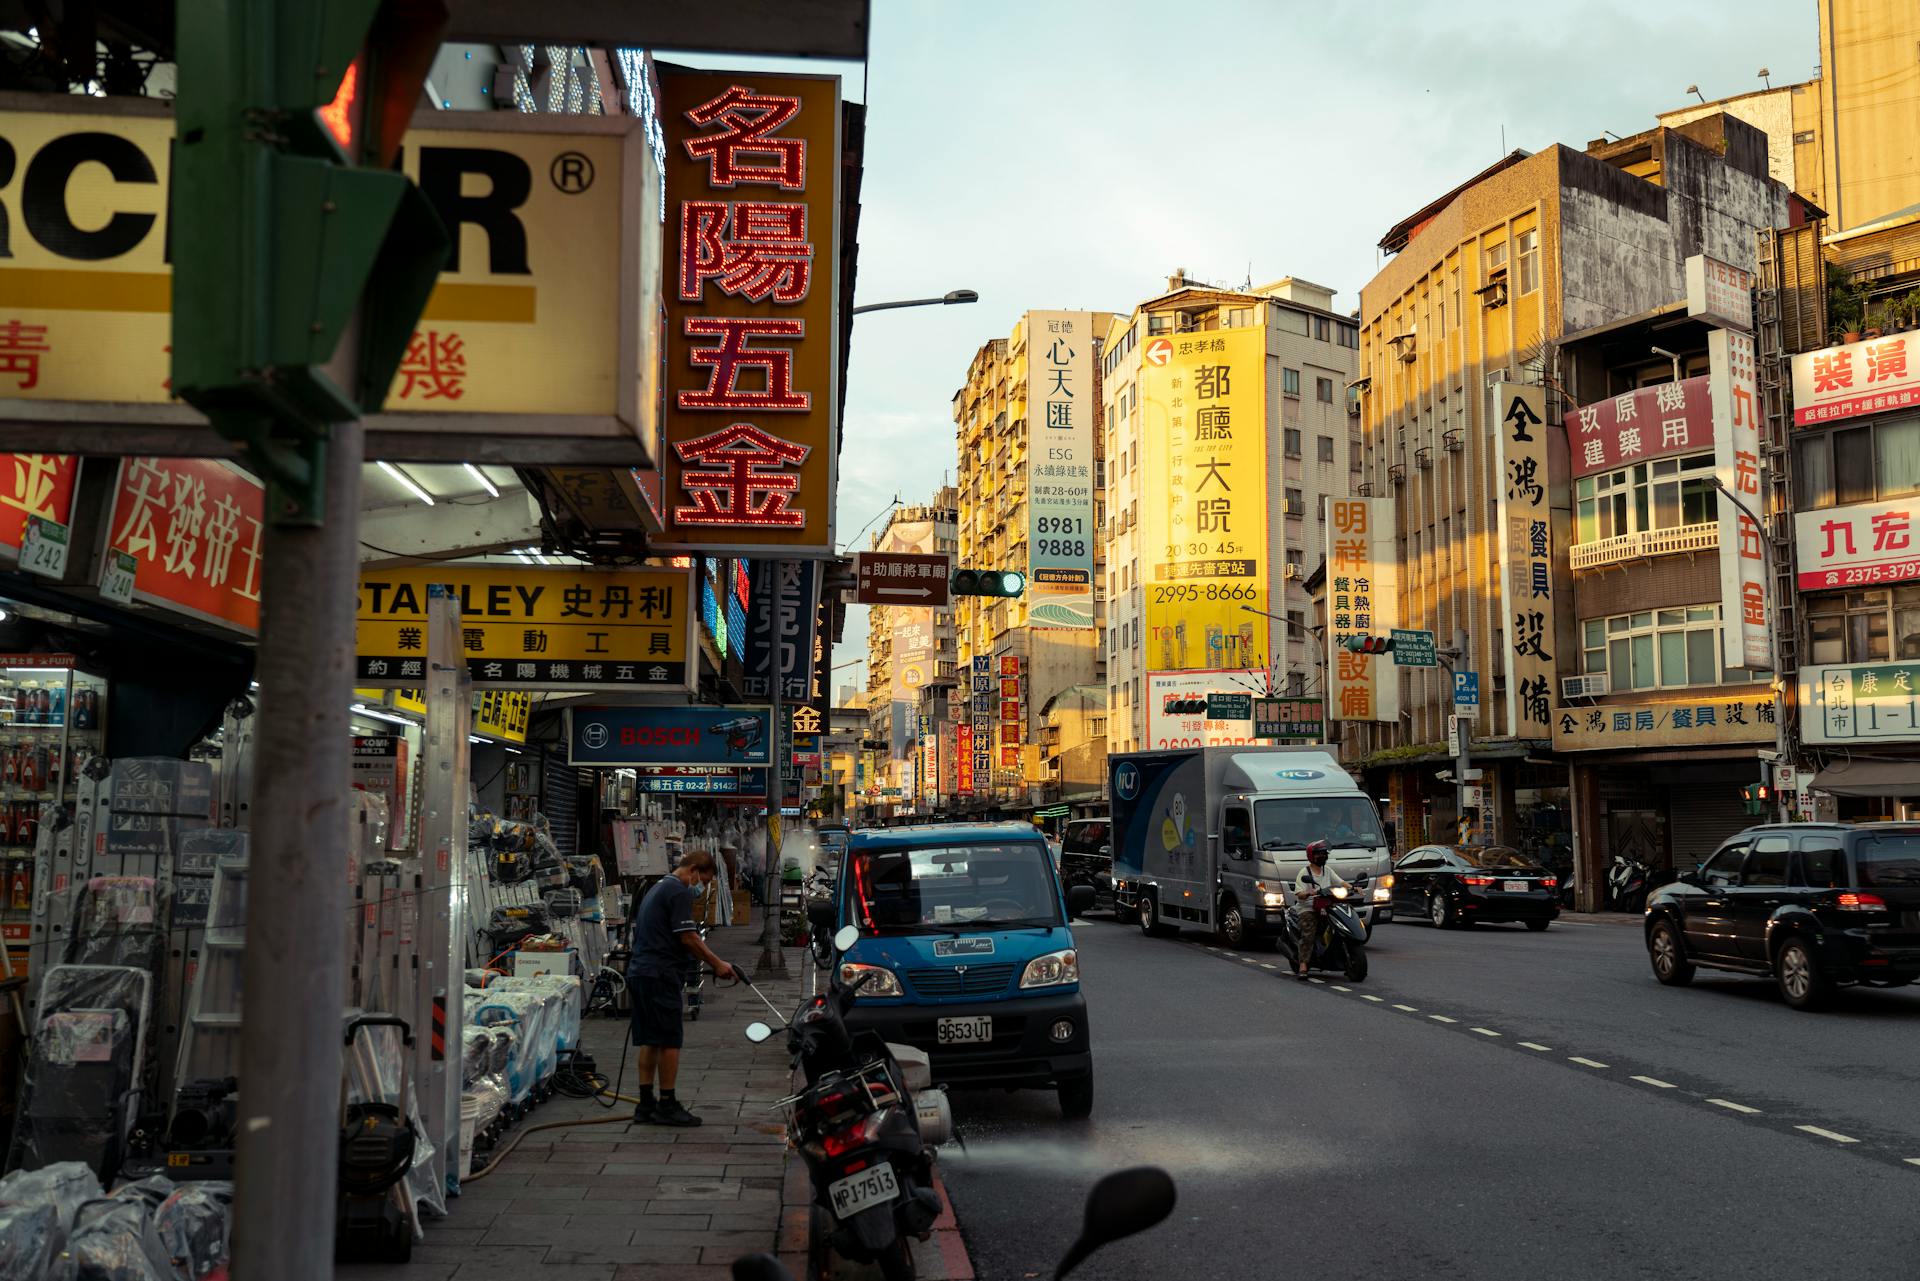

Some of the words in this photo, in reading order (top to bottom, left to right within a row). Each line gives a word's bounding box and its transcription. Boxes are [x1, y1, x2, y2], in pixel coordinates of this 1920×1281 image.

[673, 84, 814, 528] 名陽五金
[1047, 320, 1073, 333] 冠德
[1179, 338, 1225, 355] 忠孝橋
[1814, 339, 1908, 393] 裝潢
[1046, 337, 1075, 429] 心天匯
[1579, 379, 1714, 434] 玖原機
[1049, 448, 1073, 461] ESG
[1172, 378, 1184, 525] 新北第二行政中心
[1733, 385, 1765, 626] 九宏五金
[1038, 517, 1082, 534] 8981
[1334, 502, 1367, 573] 明祥
[34, 544, 61, 570] 242
[1038, 539, 1085, 557] 9888
[873, 562, 946, 578] 助順將軍廟
[111, 574, 131, 597] 240
[1155, 584, 1257, 604] 2995-8666
[357, 582, 545, 617] TALEY
[561, 584, 673, 619] 史丹利
[1152, 625, 1184, 641] TOP
[1210, 634, 1250, 650] CITY
[744, 676, 806, 697] 正行
[1831, 675, 1848, 732] 台北市
[620, 728, 700, 746] BOSCH
[927, 746, 935, 778] YAMAHA
